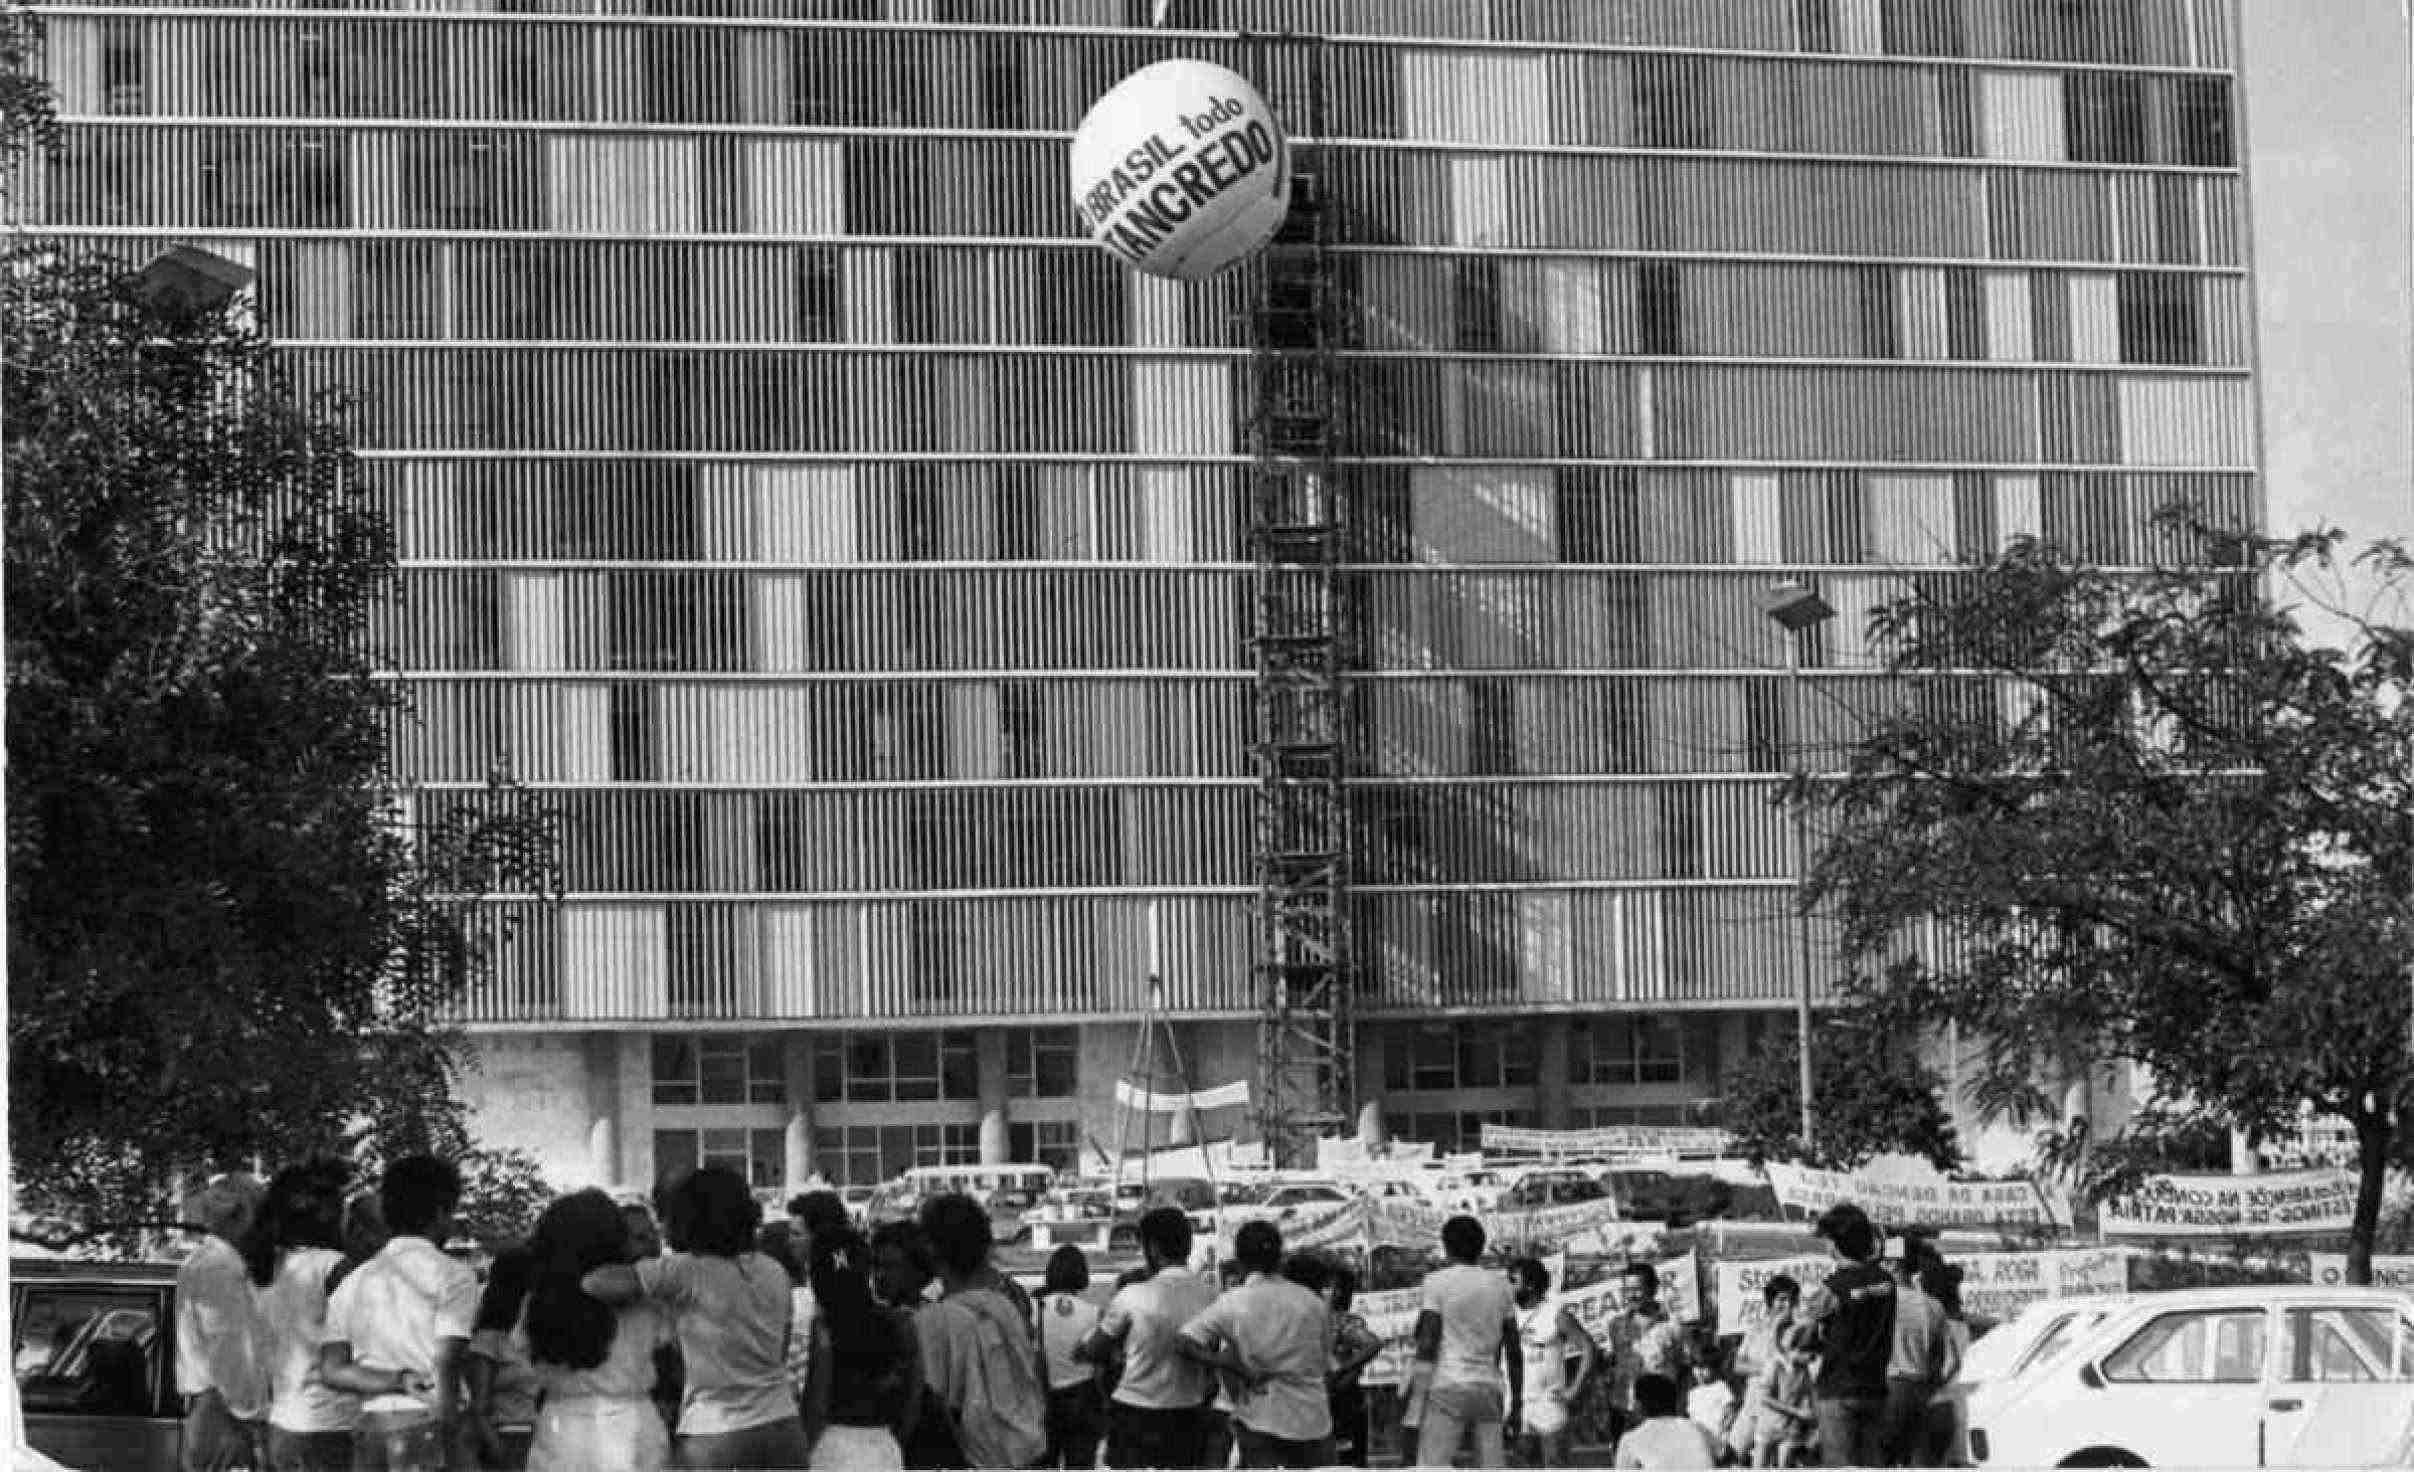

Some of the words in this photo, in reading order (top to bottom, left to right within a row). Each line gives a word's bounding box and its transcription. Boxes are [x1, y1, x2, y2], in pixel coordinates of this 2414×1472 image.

[1086, 134, 1186, 223] BRASIL
[1179, 96, 1243, 139] todo
[1103, 119, 1272, 262] TANCREDO
